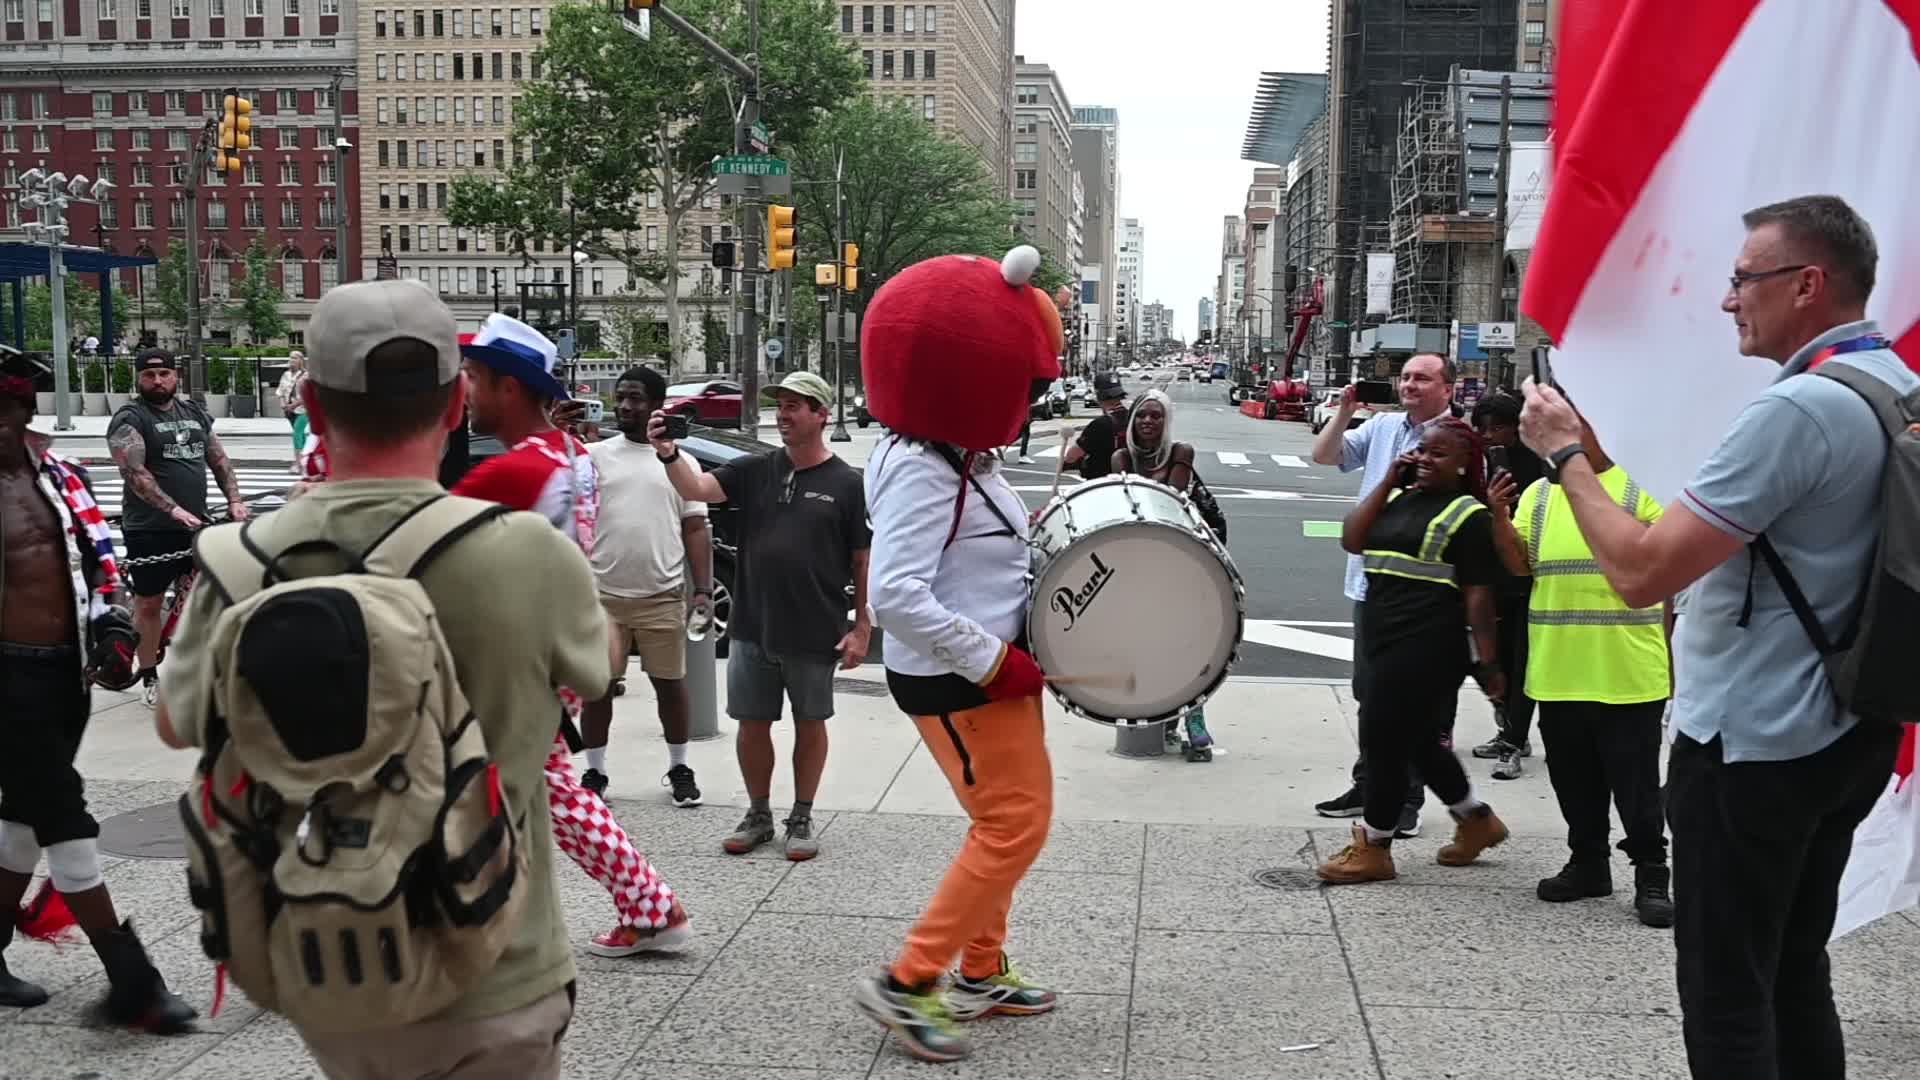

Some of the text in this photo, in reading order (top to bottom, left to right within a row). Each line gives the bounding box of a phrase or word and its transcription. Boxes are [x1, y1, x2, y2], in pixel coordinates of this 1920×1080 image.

[714, 163, 726, 174] JF
[730, 163, 771, 175] KENNEDY
[1050, 551, 1112, 632] Pearl
